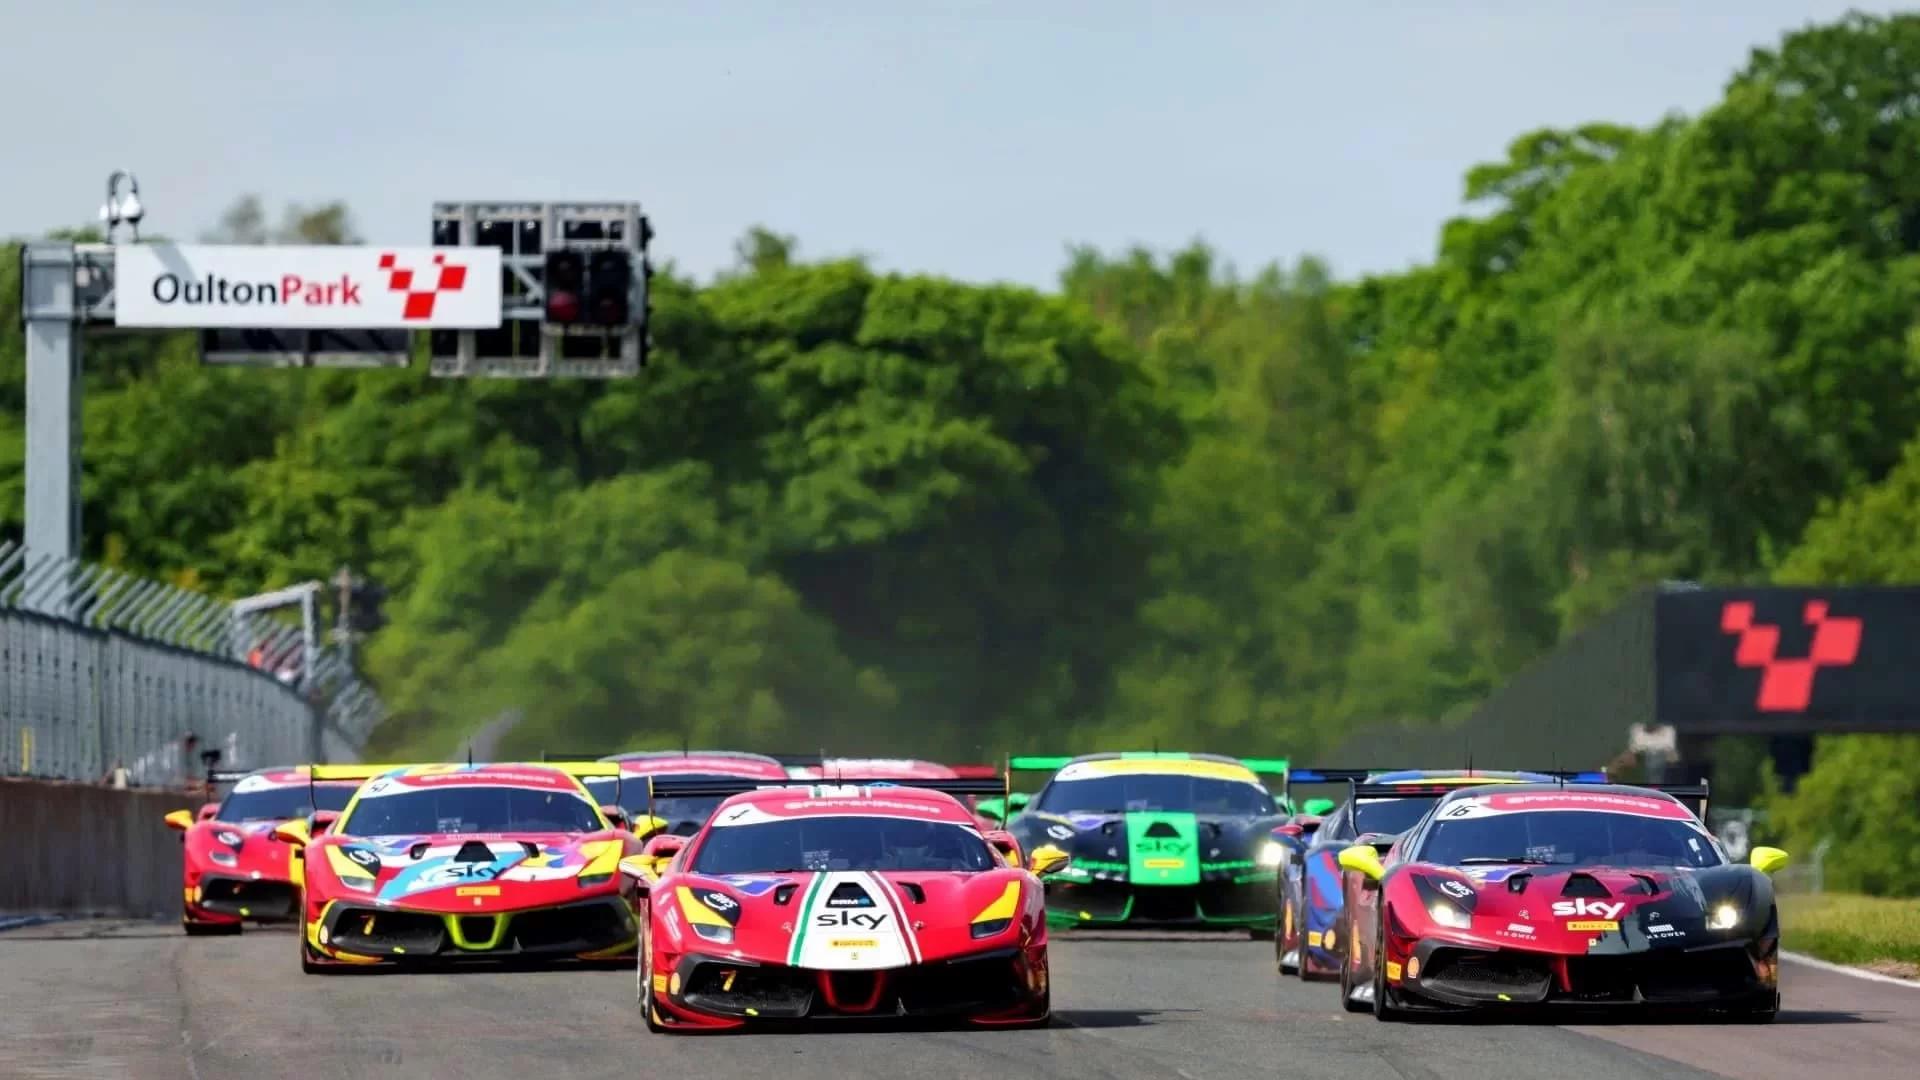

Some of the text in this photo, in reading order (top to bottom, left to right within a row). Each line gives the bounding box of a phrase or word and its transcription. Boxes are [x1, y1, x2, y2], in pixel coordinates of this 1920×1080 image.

[1135, 838, 1192, 855] sky
[445, 864, 507, 880] sky
[1551, 897, 1625, 919] sky
[816, 910, 888, 930] sky
